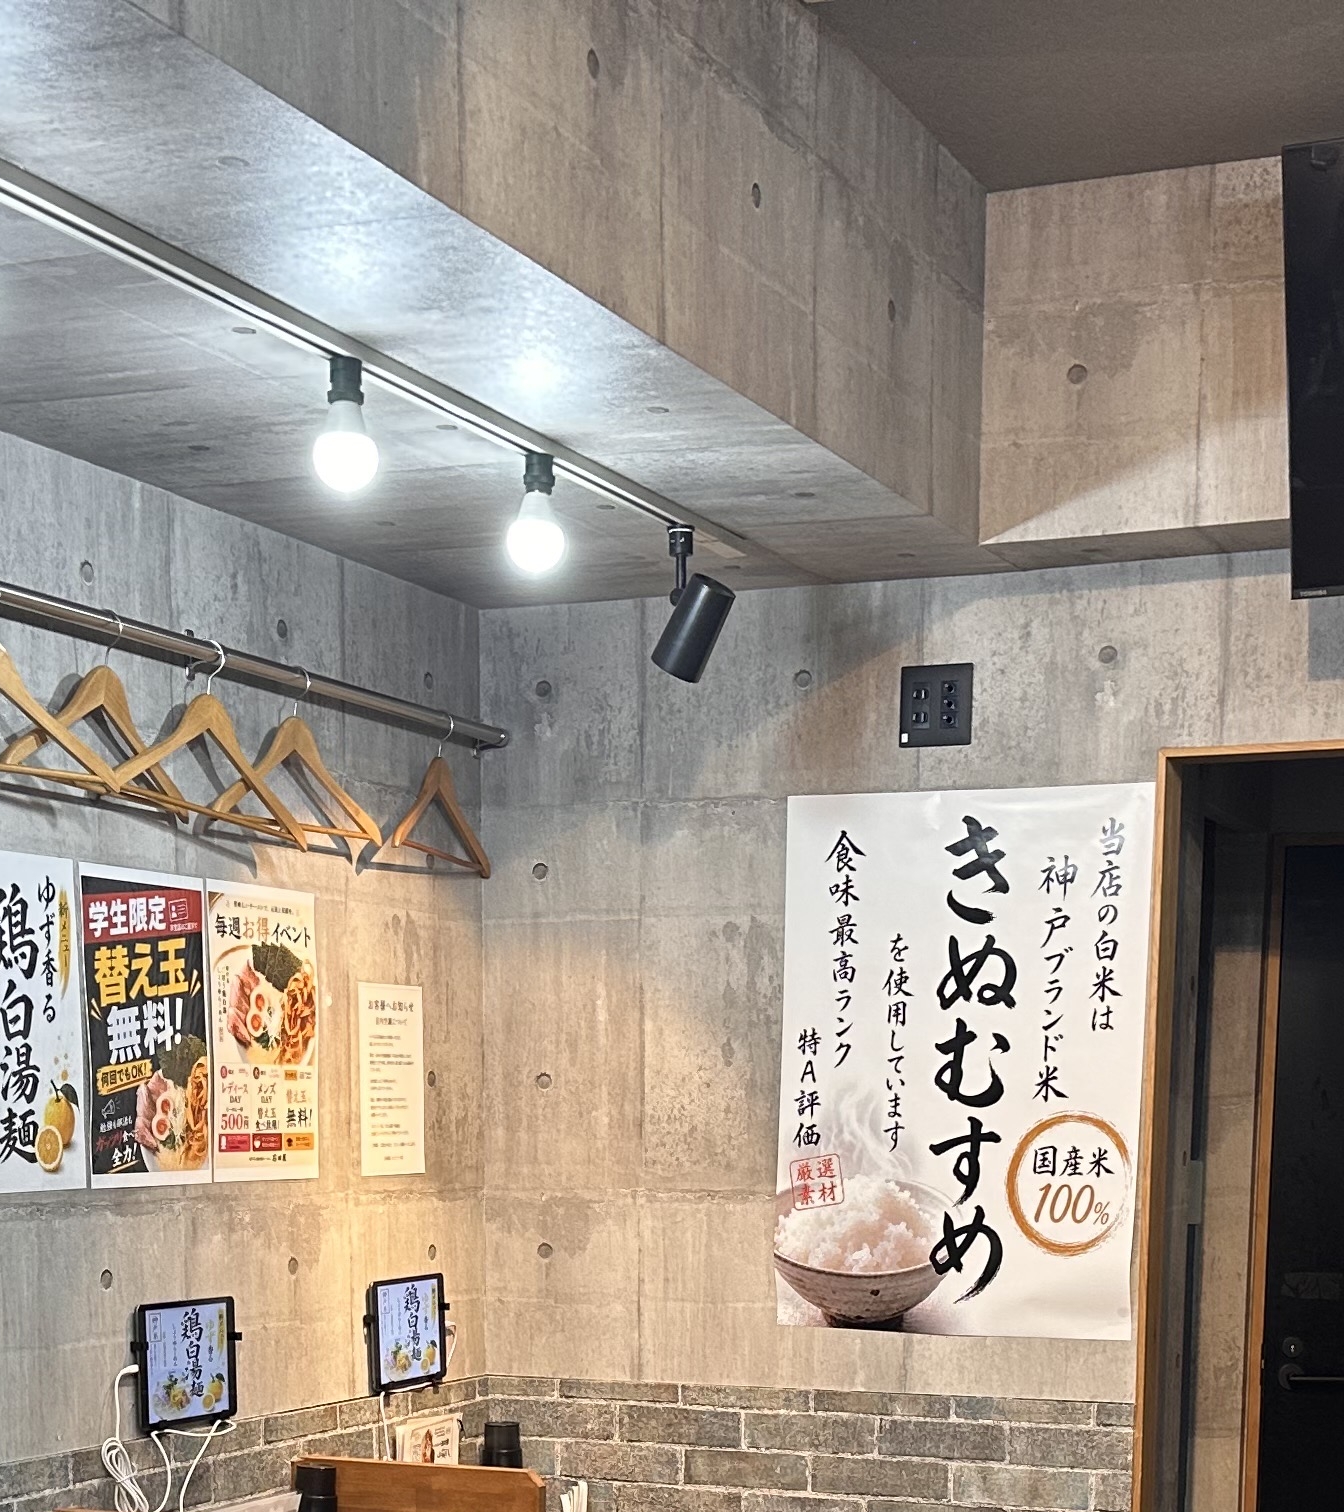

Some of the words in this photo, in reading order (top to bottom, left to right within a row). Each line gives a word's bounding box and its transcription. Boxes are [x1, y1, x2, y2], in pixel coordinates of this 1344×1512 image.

[37, 876, 58, 1023] ゆず香る
[58, 902, 70, 968] 新メニュー
[88, 896, 166, 939] 学生限定
[214, 913, 310, 948] 毎週お得イベント
[824, 829, 867, 1069] 食味最高ランク
[1090, 816, 1128, 1032] 当店の白米は
[94, 937, 189, 1007] 替え玉
[1032, 856, 1079, 1103] 神戸ブランド米
[107, 997, 184, 1065] 無料!
[882, 932, 914, 1152] を使用しています
[928, 815, 1018, 1305] きぬむすめ
[793, 1027, 822, 1149] 特A評価
[111, 1143, 138, 1168] 全力!
[796, 1157, 837, 1183] 厳選
[1032, 1144, 1115, 1179] 国産米
[797, 1180, 837, 1207] 素材
[1032, 1181, 1110, 1226] 100%
